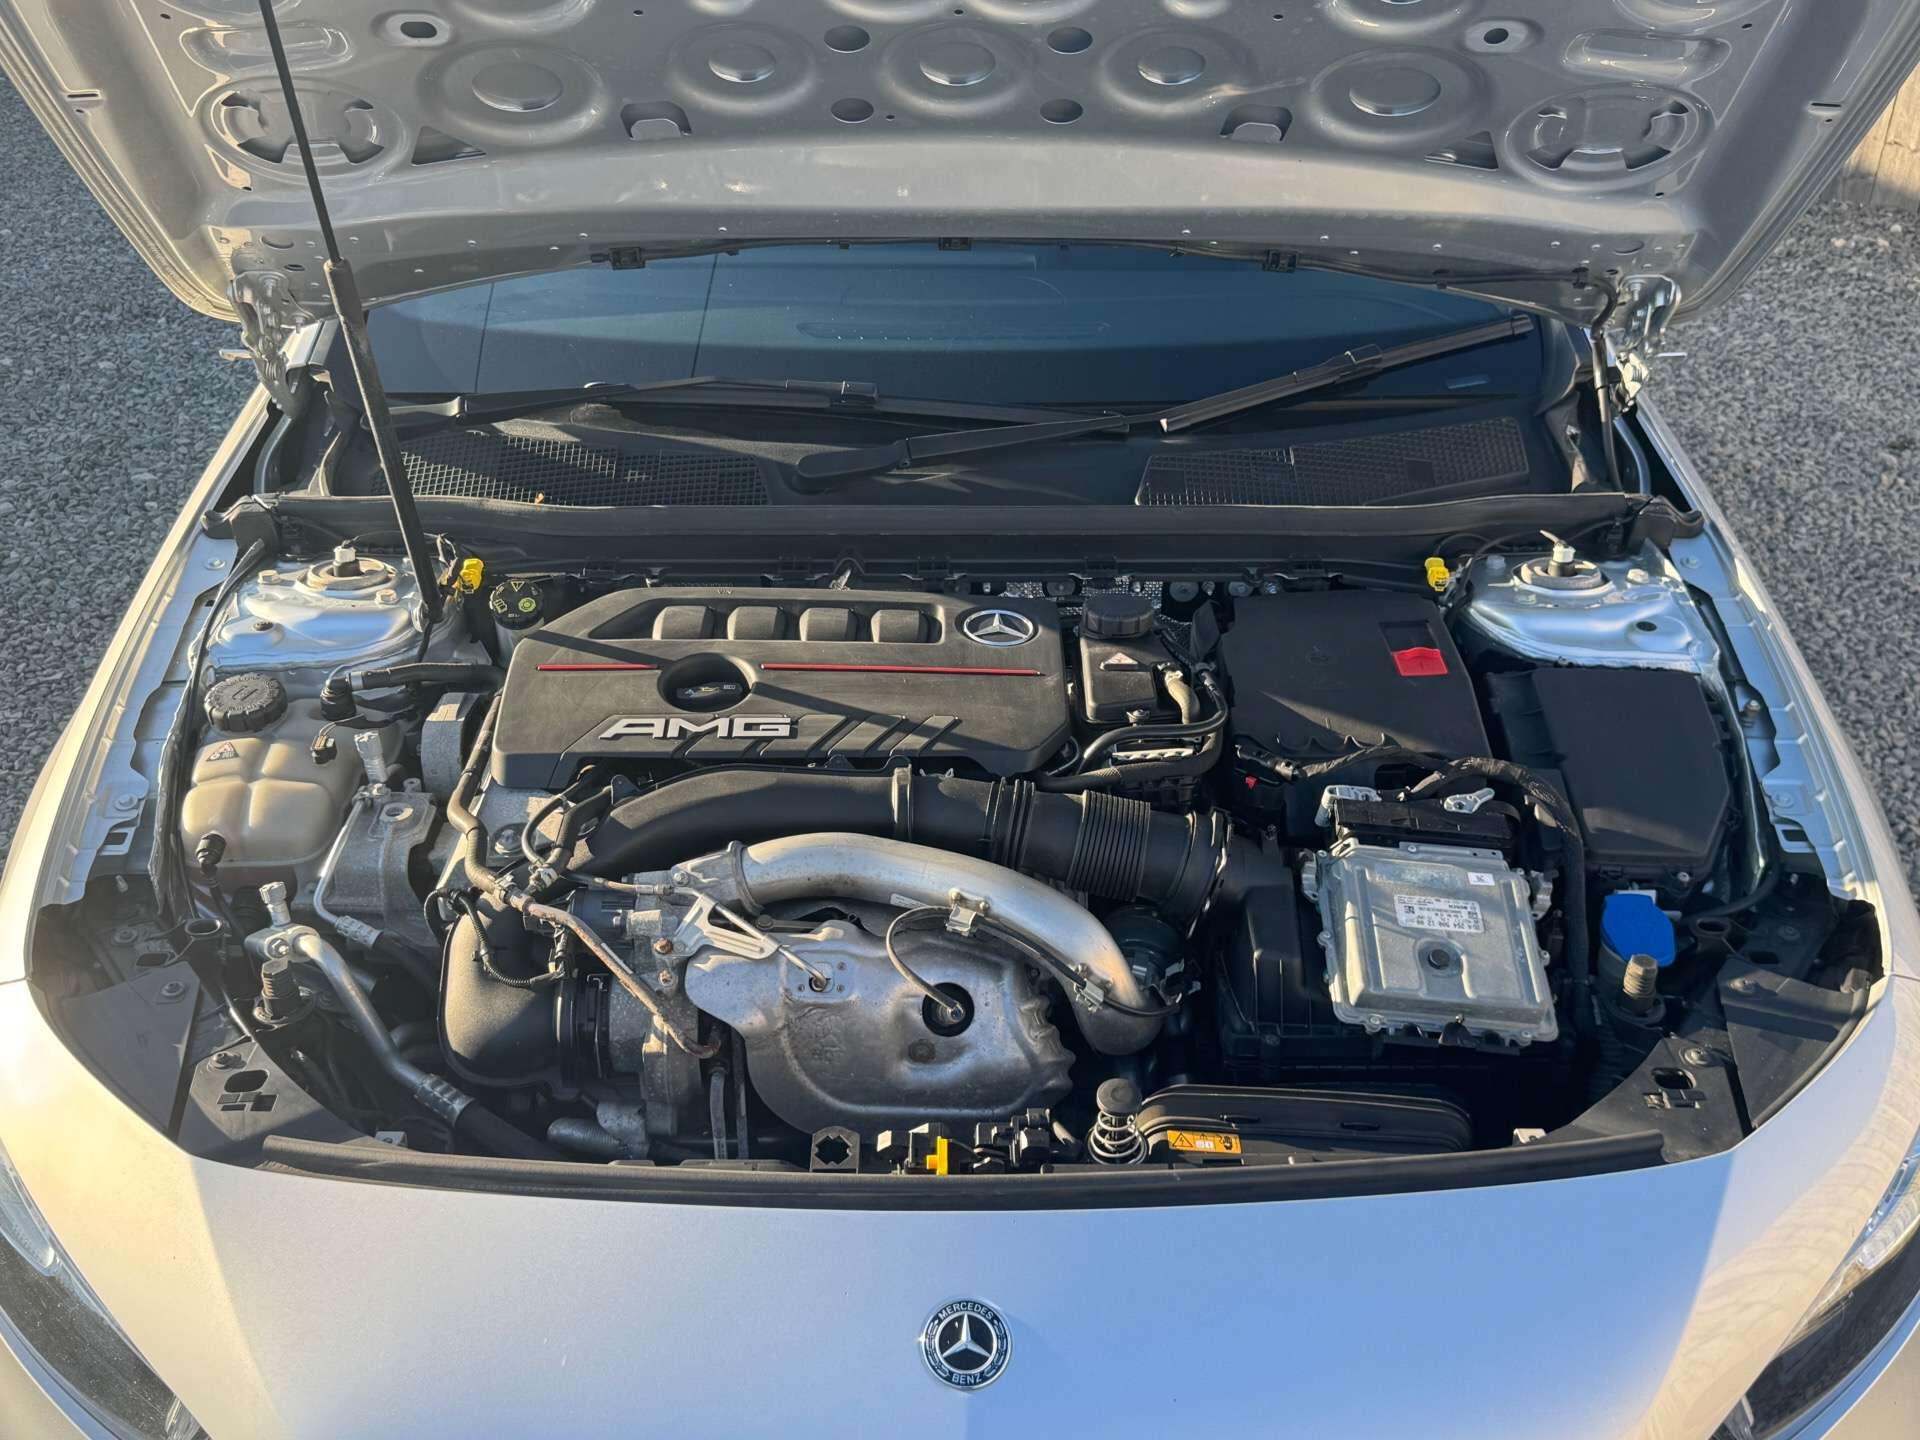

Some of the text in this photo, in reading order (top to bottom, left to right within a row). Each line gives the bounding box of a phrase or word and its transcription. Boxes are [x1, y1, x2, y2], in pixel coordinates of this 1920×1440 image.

[599, 717, 791, 738] AMG
[938, 1302, 994, 1320] MERCEDES
[952, 1373, 982, 1385] BENZ
